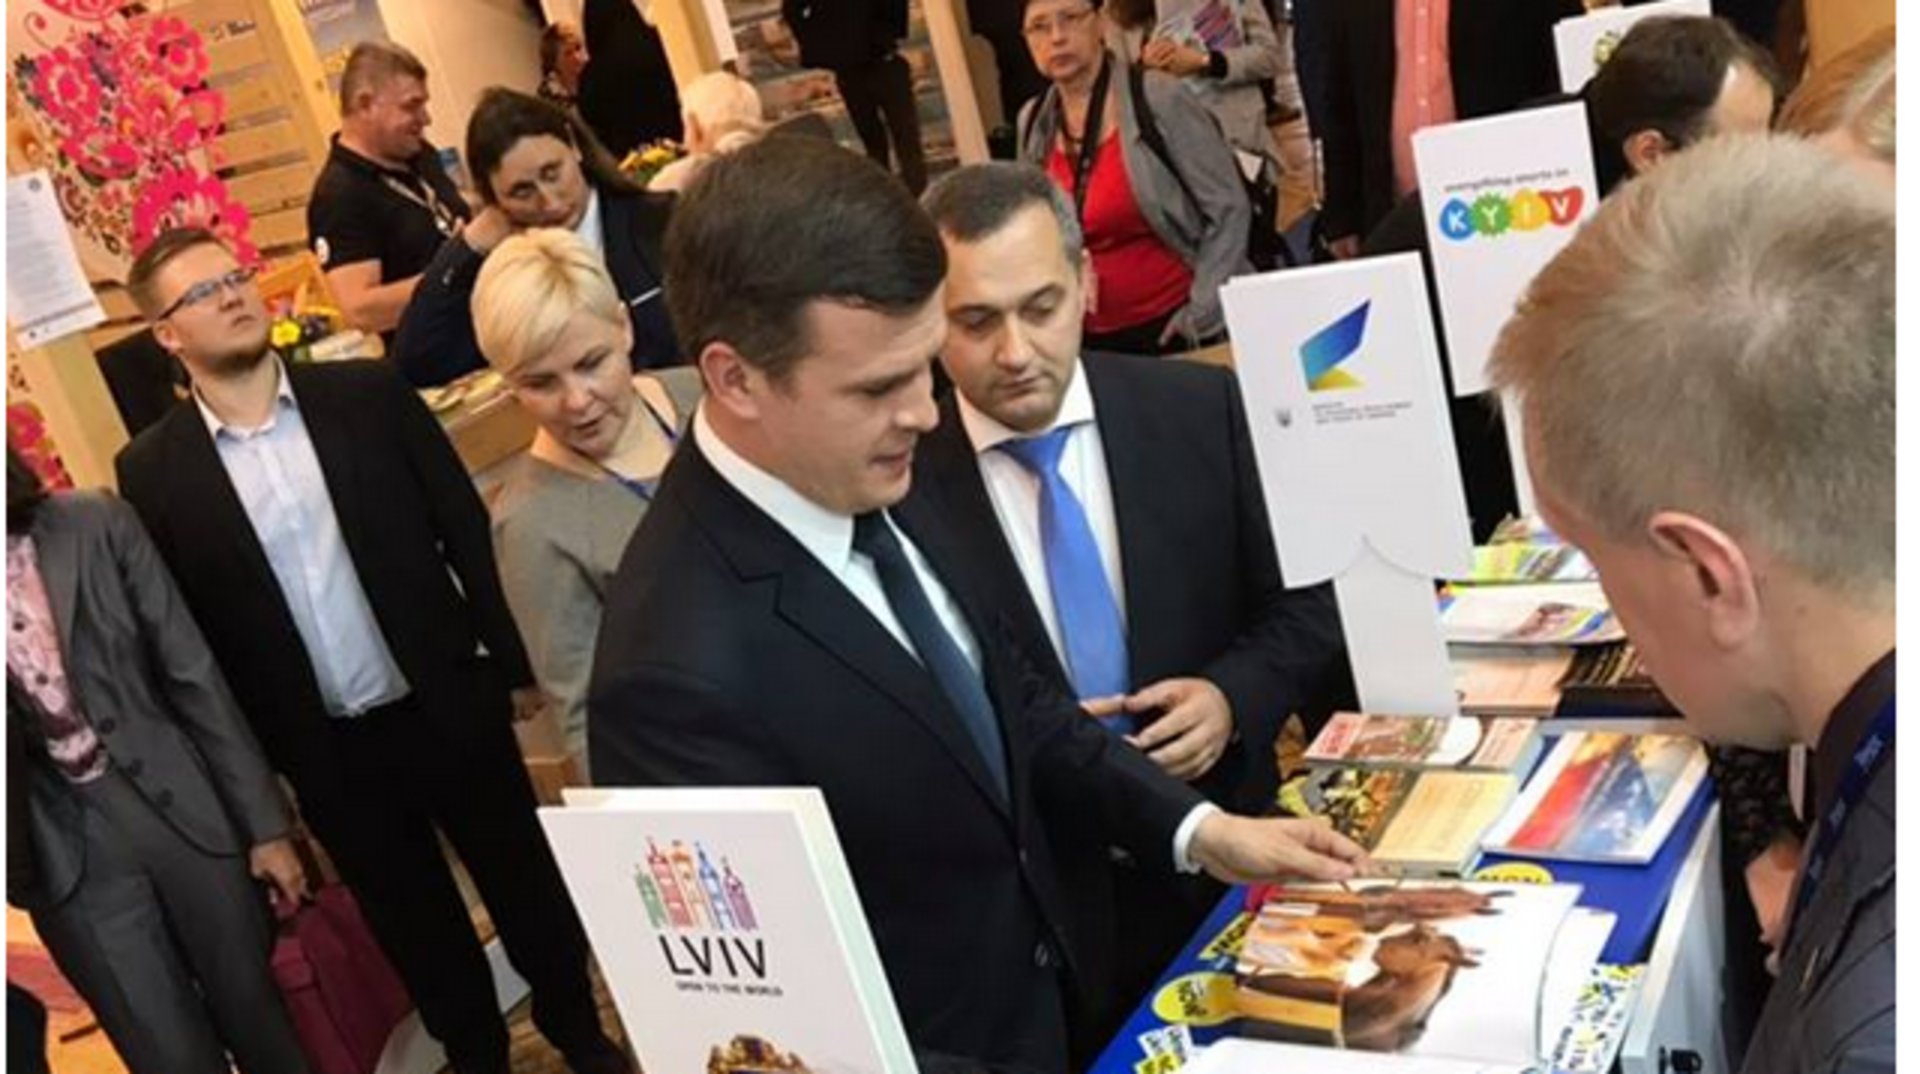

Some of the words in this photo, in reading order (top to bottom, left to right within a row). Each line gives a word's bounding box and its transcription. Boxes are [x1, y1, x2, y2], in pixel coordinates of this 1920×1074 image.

[1446, 192, 1572, 234] KYIV
[658, 934, 765, 979] LVIV
[676, 981, 704, 992] OPEN
[705, 982, 720, 994] TO
[721, 983, 741, 995] THE
[744, 985, 783, 997] WORLD
